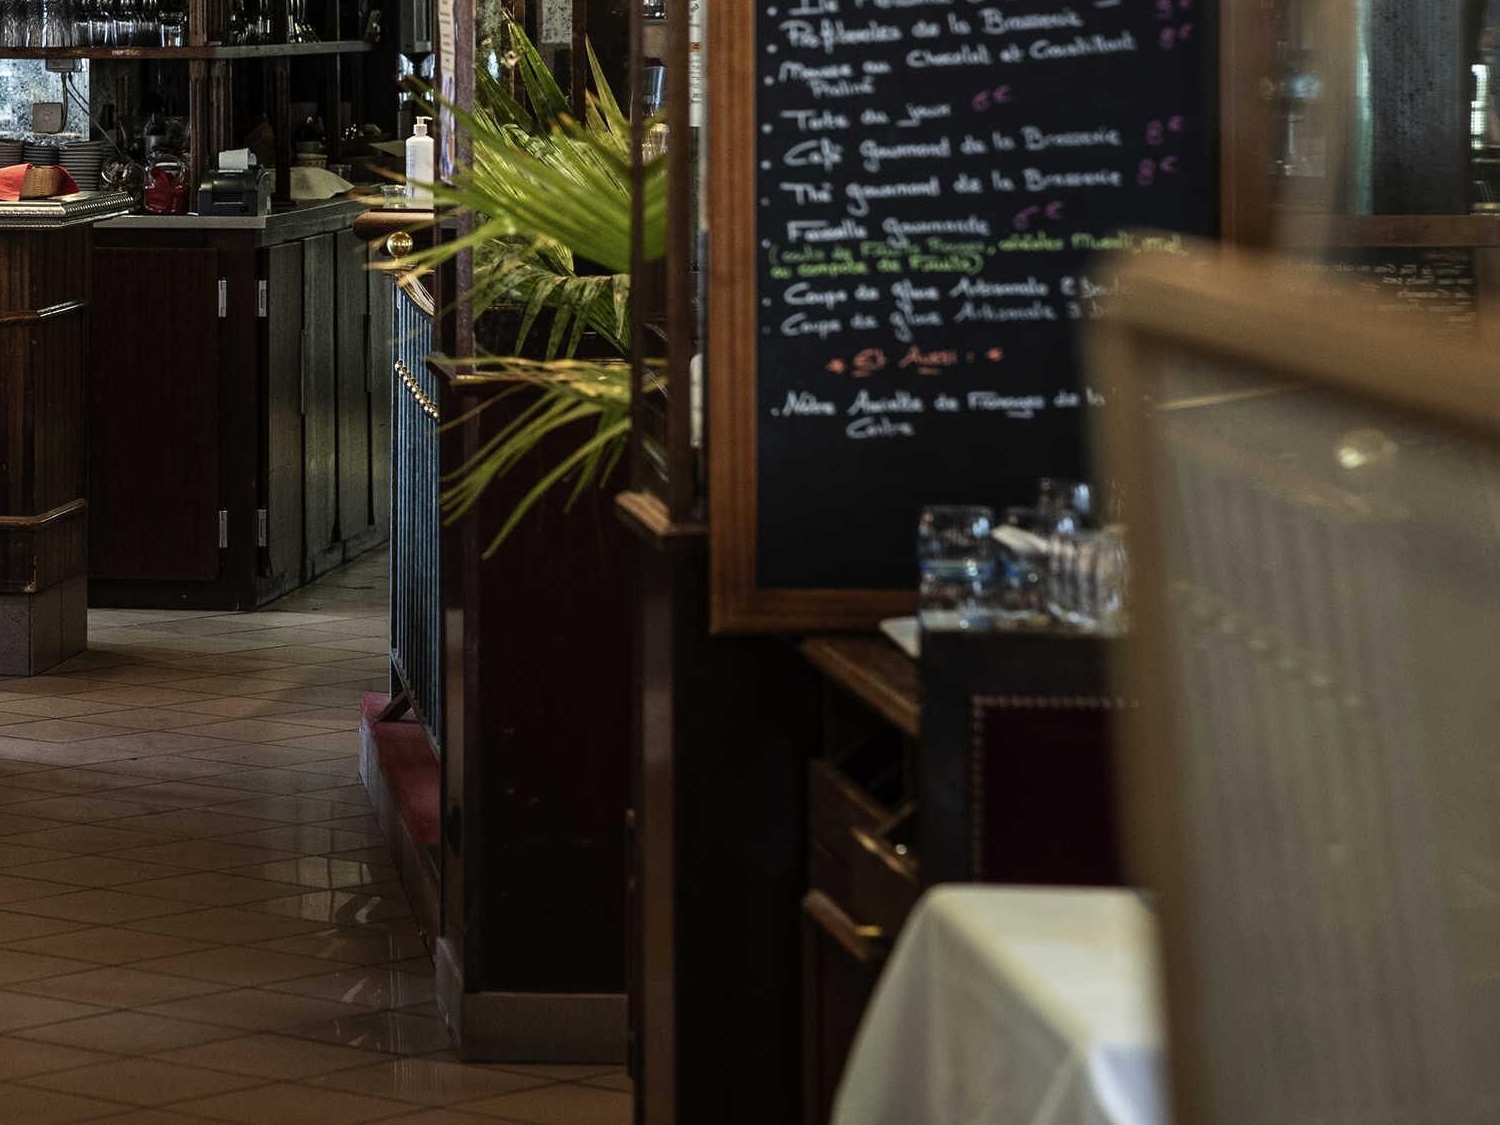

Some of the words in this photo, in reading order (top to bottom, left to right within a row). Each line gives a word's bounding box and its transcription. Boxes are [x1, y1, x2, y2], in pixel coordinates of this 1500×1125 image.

[911, 20, 940, 38] de
[947, 11, 971, 35] la
[862, 61, 891, 74] au
[905, 43, 993, 69] Chocolat
[999, 42, 1024, 64] et
[780, 108, 850, 131] Tarte
[860, 109, 890, 125] du
[783, 136, 844, 173] Café
[960, 134, 987, 155] de
[992, 130, 1017, 152] la
[780, 181, 833, 205] Thé
[953, 172, 983, 194] de
[991, 169, 1015, 192] la
[853, 283, 881, 302] de
[850, 313, 879, 329] de
[933, 392, 959, 412] de
[1052, 389, 1082, 408] de
